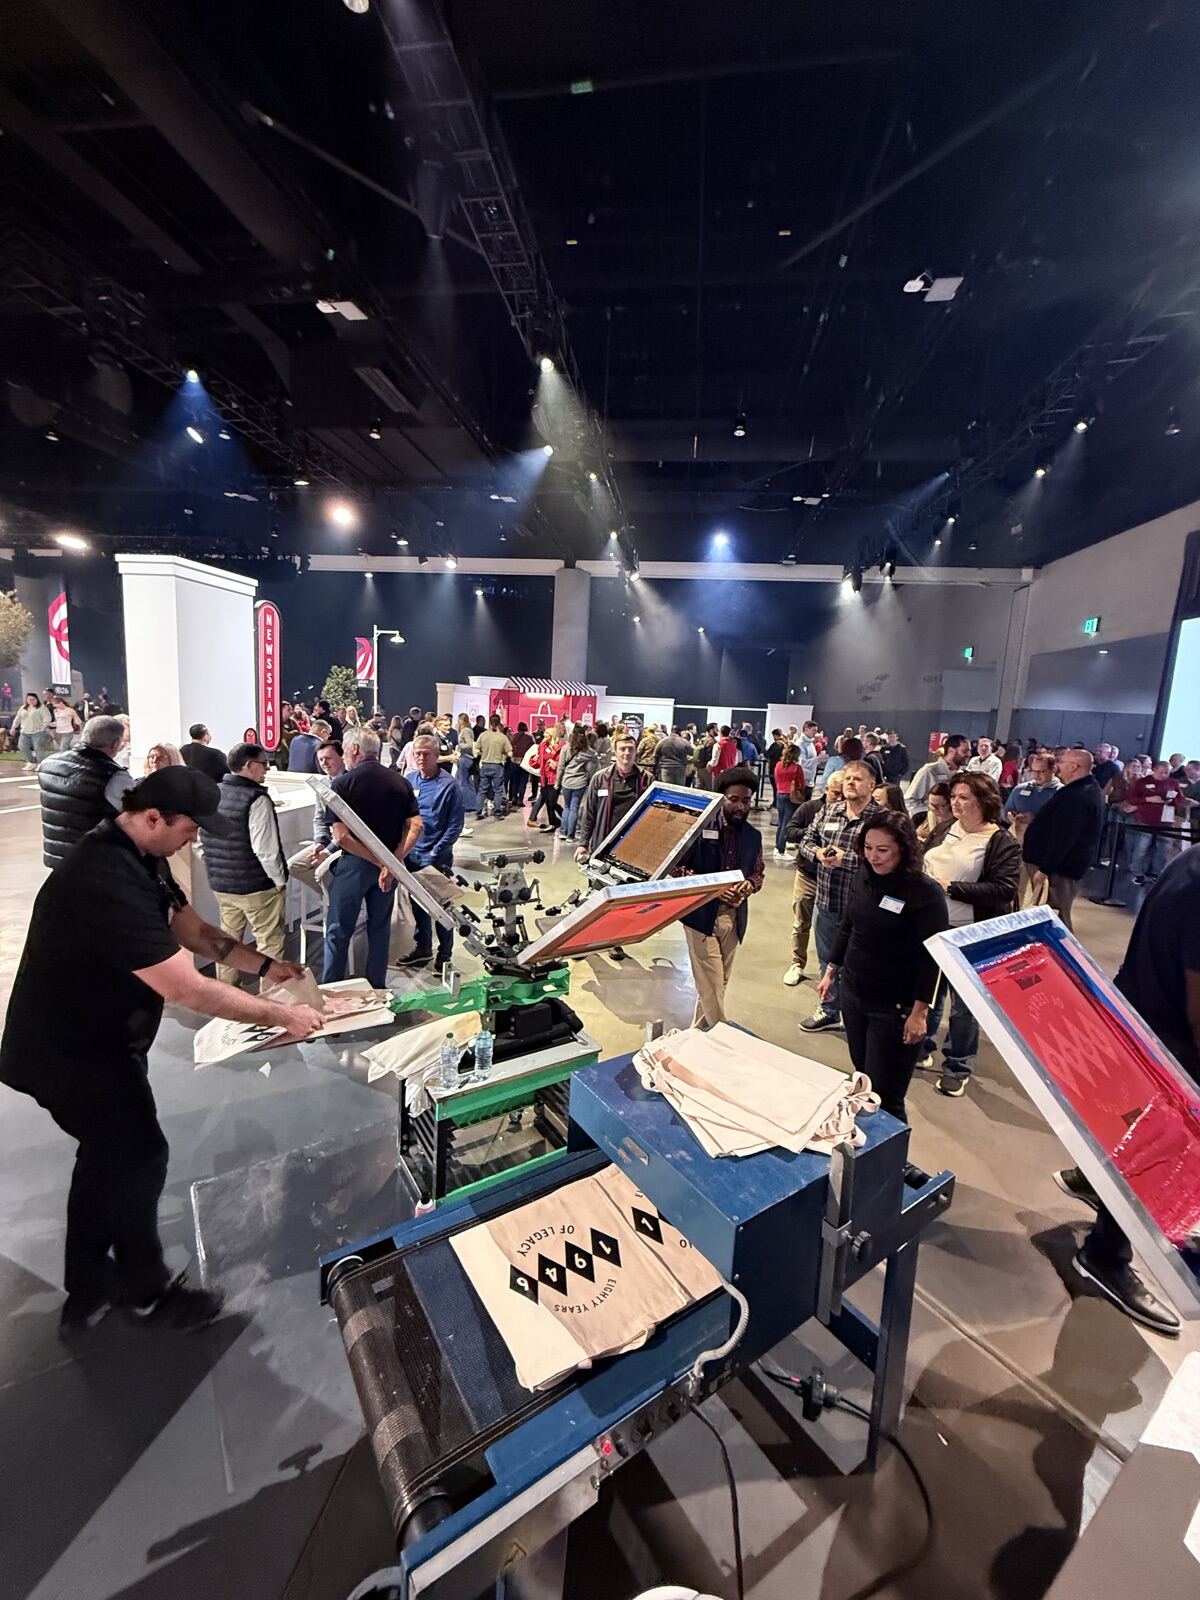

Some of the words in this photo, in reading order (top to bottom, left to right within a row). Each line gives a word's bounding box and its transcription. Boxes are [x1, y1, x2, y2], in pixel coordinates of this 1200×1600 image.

[265, 613, 274, 742] NEWSSTAND
[516, 1224, 556, 1257] LEGACY
[559, 1224, 575, 1235] OF
[592, 1278, 617, 1307] EIGHTY
[554, 1303, 590, 1314] YEARS
